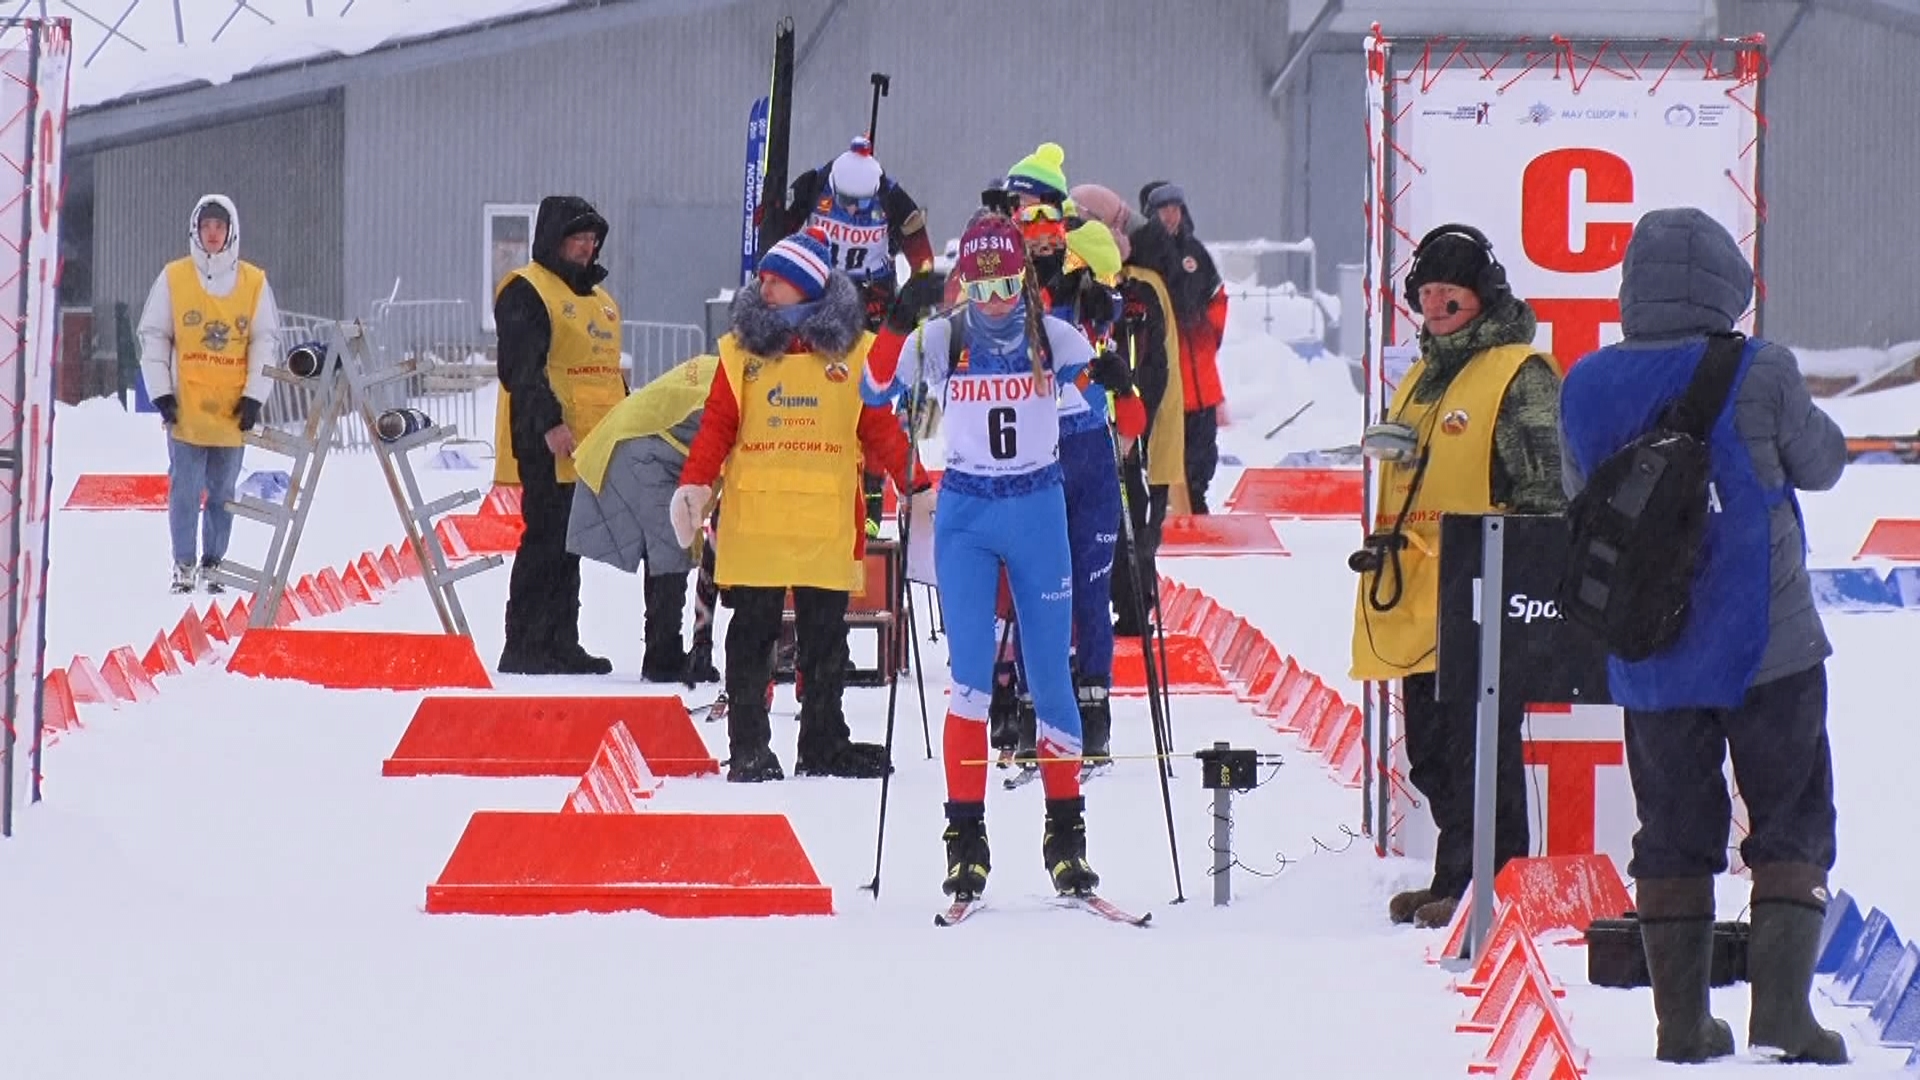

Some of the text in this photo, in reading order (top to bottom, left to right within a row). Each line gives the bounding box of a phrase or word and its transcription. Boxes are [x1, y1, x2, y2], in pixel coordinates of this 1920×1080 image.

[963, 236, 1015, 257] RUSSIA
[950, 375, 1053, 402] ЗЛАТОУТ
[783, 418, 816, 426] TOYOTA
[988, 407, 1017, 460] 6
[1508, 594, 1563, 623] Spo
